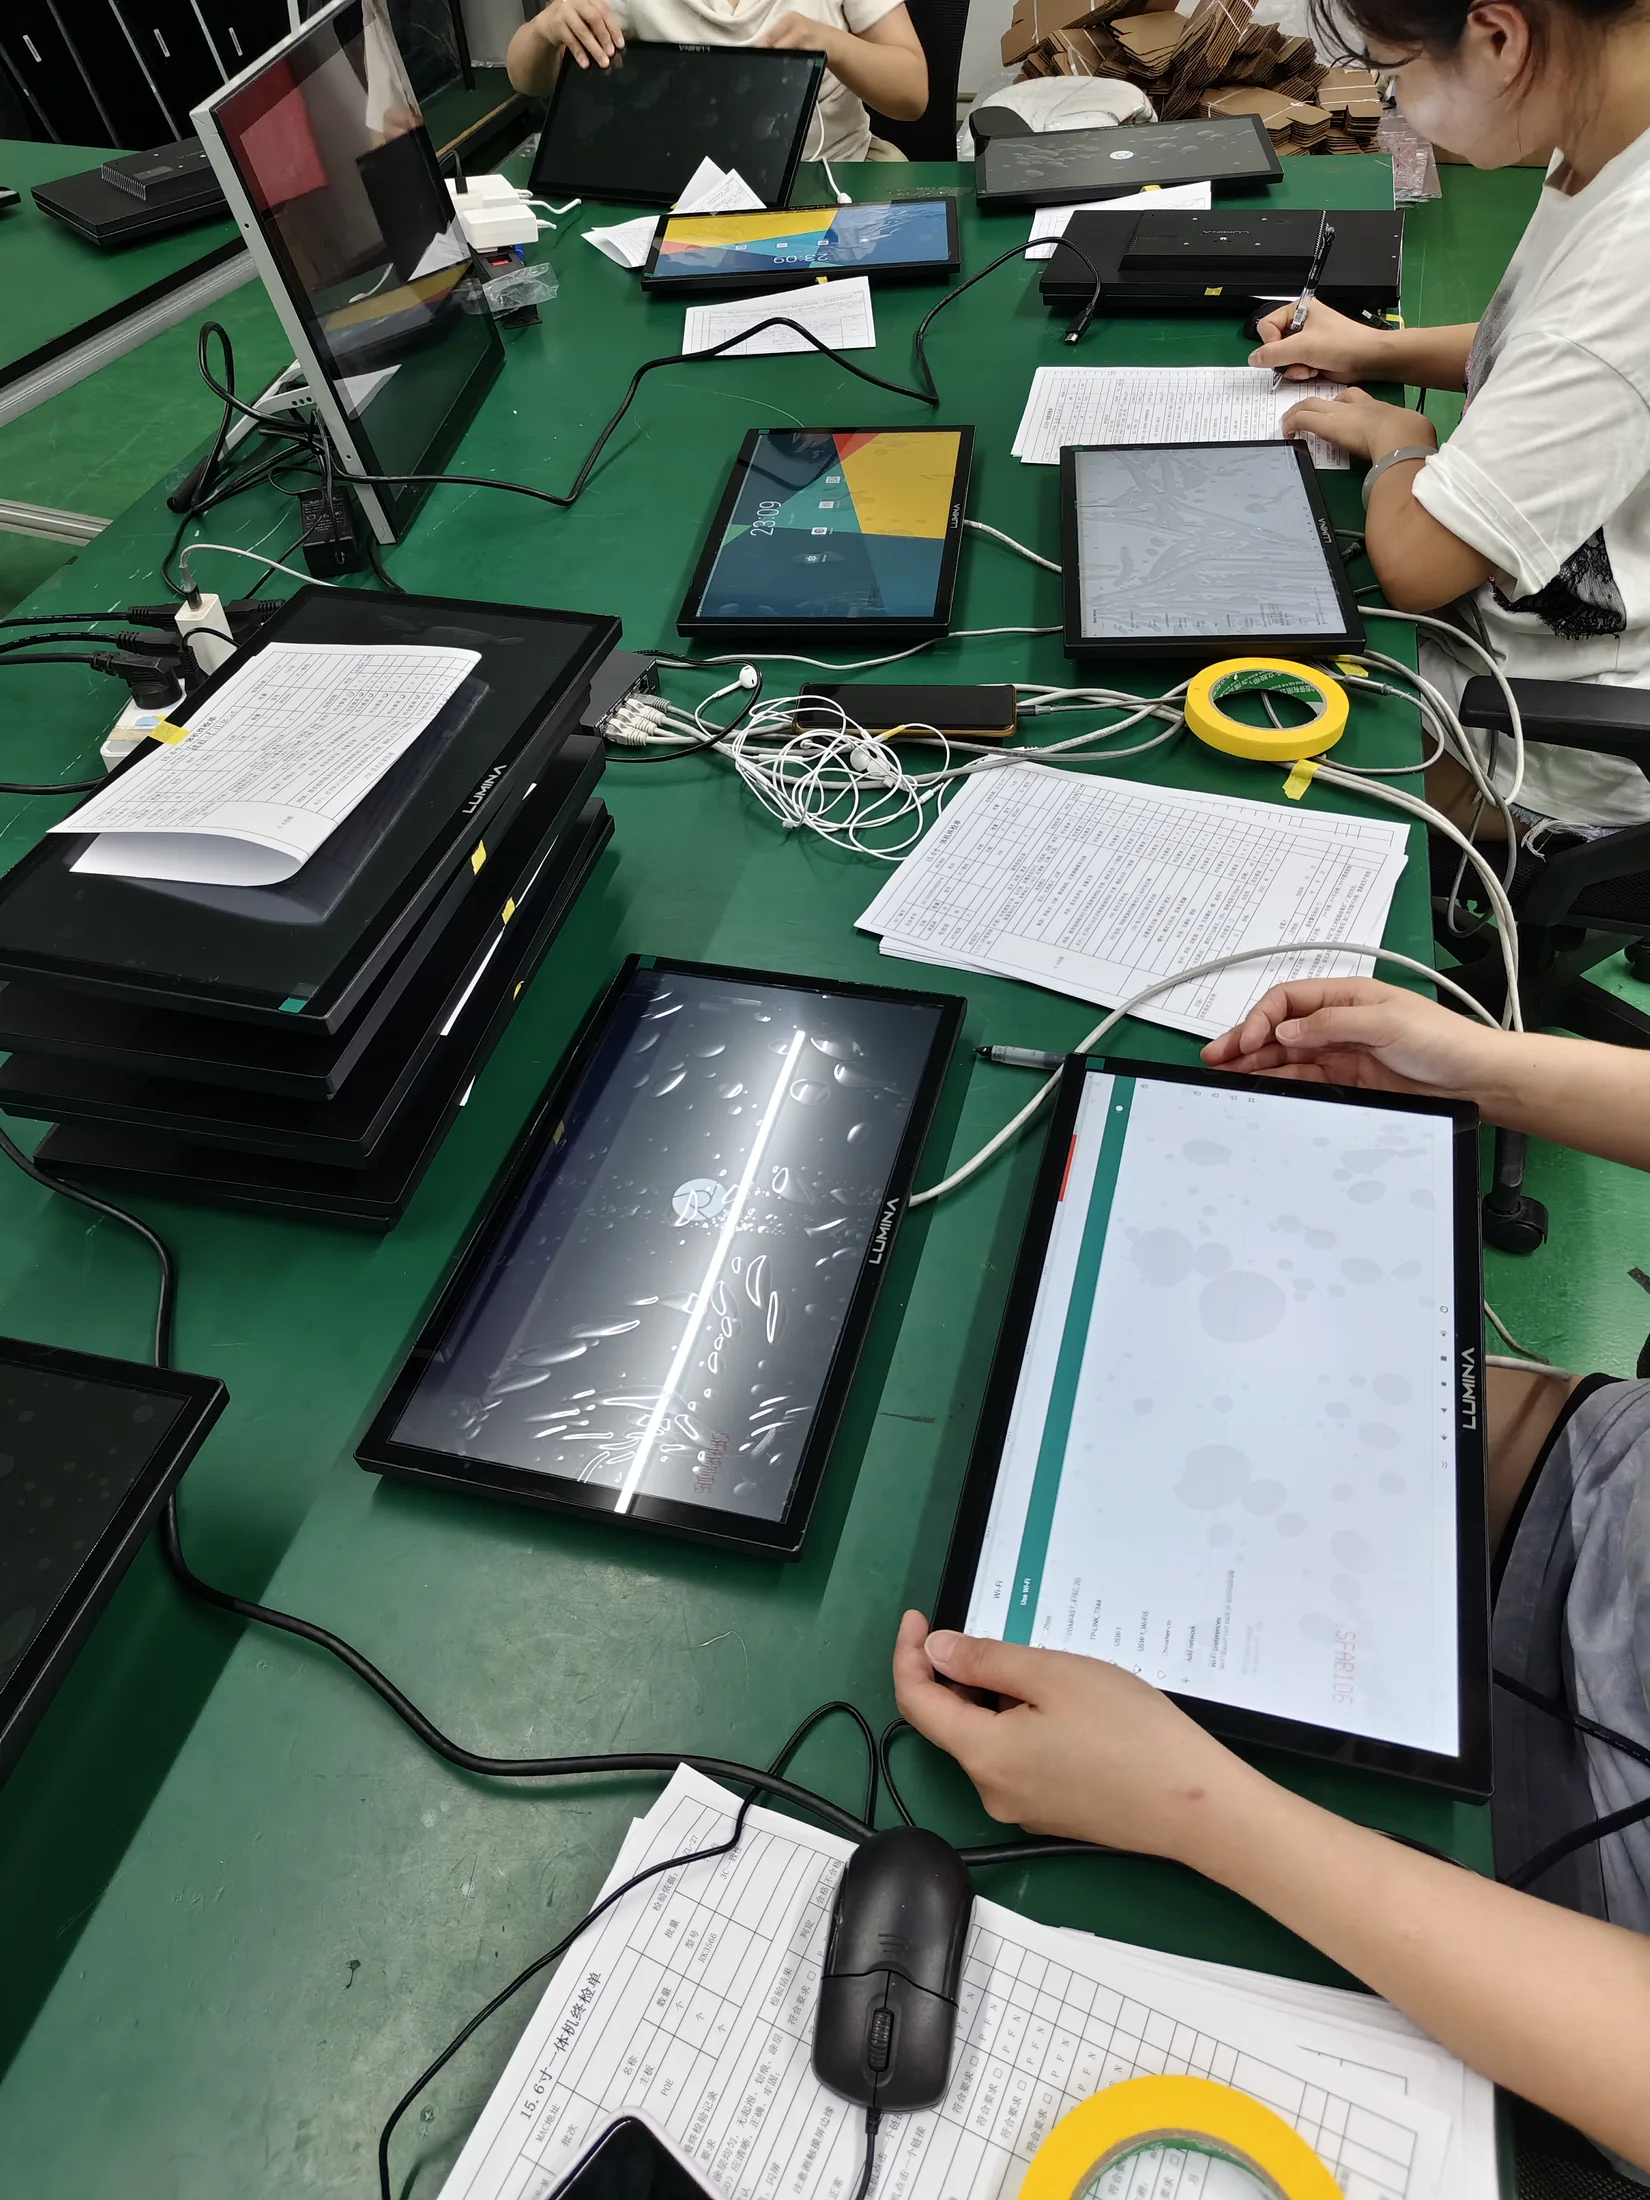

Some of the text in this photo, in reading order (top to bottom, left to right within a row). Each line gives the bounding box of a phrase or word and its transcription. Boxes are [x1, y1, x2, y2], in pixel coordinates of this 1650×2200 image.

[773, 252, 829, 264] 23:09
[750, 501, 781, 536] 23:09
[462, 765, 507, 814] LUMINA
[868, 1198, 900, 1264] LUMINA
[1461, 1347, 1477, 1430] LUMINA
[993, 1580, 1003, 1599] Wi-Fi
[1022, 1577, 1031, 1594] Wi-Fi
[825, 1859, 842, 1885] 不合格
[816, 1887, 829, 1904] 合格
[663, 1918, 680, 1939] 批量
[685, 1929, 699, 1950] 型号
[800, 1920, 814, 1940] 判定
[699, 1933, 717, 1963] RK3566
[656, 1986, 672, 2008] 数量
[770, 1966, 793, 2007] 检验结果
[966, 1991, 975, 2000] N
[675, 2000, 684, 2010] 个
[695, 2012, 705, 2022] 个
[787, 1985, 811, 2026] 符合要求
[717, 2024, 727, 2034] 个
[978, 2033, 987, 2041] P
[989, 2003, 998, 2011] N
[1002, 2045, 1010, 2053] P
[1013, 2014, 1021, 2022] N
[520, 1971, 602, 2120] 15.6寸一体机终检单
[1026, 2026, 1045, 2065] P F N
[1051, 2038, 1070, 2078] P F N
[623, 2055, 639, 2077] 名称
[640, 2063, 655, 2087] 主板
[1077, 2052, 1096, 2092] P F N
[660, 2078, 674, 2097] POE
[952, 2070, 974, 2113] 符合要求
[976, 2083, 998, 2127] 符合要求
[1000, 2095, 1022, 2139] 符合要求
[536, 2104, 561, 2143] MAC地址
[561, 2124, 578, 2147] 批次
[1026, 2108, 1048, 2152] 符合要求
[700, 2139, 716, 2160] 要求
